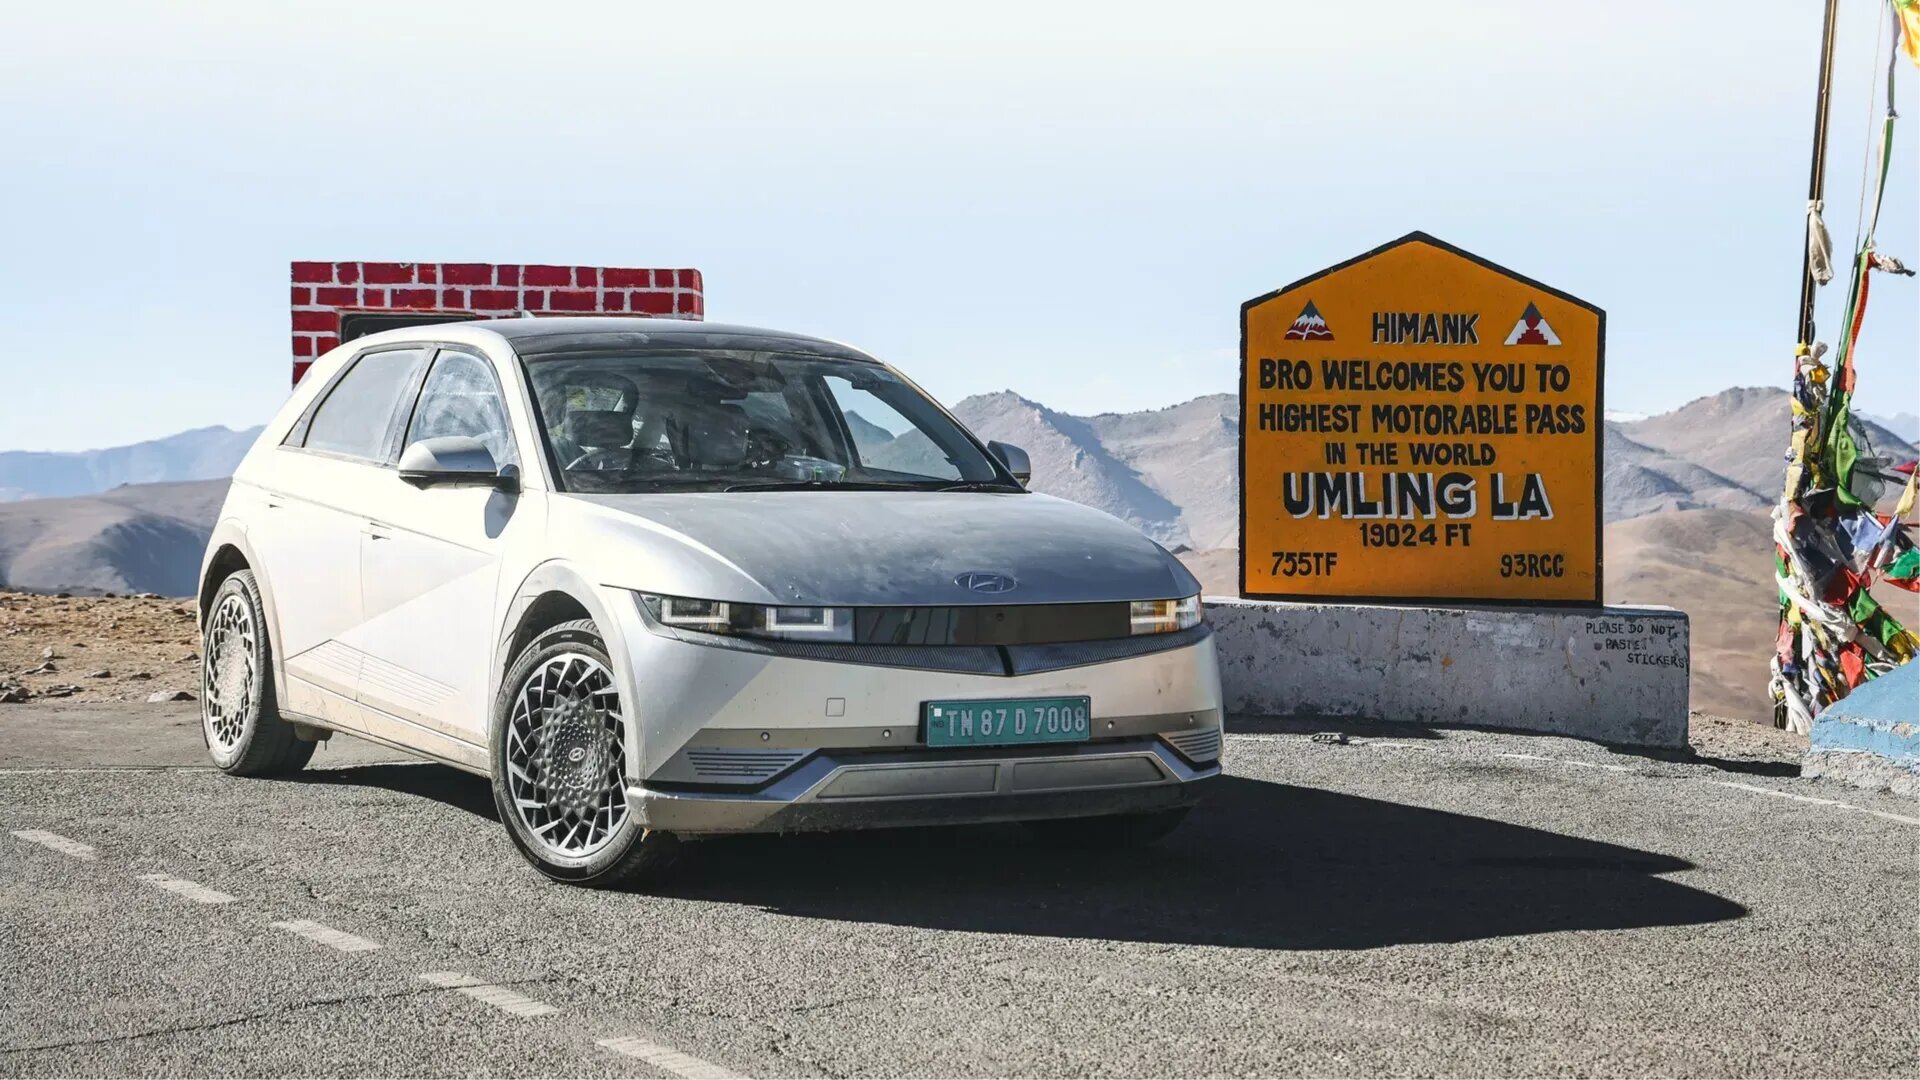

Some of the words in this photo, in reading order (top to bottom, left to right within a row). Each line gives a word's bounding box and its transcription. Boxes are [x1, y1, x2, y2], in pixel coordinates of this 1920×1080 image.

[1372, 312, 1480, 345] HIMANK
[1259, 358, 1312, 390] BRO
[1322, 360, 1464, 392] WELCOMES
[1472, 363, 1525, 393] YOU
[1536, 364, 1570, 393] TO
[1259, 403, 1361, 433] HIGHEST
[1372, 404, 1517, 435] MOTORABLE
[1526, 404, 1585, 434] PASS
[1325, 442, 1346, 465] IN
[1356, 443, 1398, 465] THE
[1409, 443, 1496, 466] WORLD
[1283, 472, 1477, 520] UMLING
[1490, 472, 1554, 520] LA
[1360, 523, 1437, 547] 19024
[1445, 524, 1472, 546] FT
[1271, 552, 1338, 577] 755TF
[1500, 553, 1564, 578] 93RCC
[1586, 622, 1624, 635] PLEASE
[1628, 624, 1644, 634] DO
[1651, 625, 1675, 636] NOT
[1605, 638, 1640, 650] PASTE
[1626, 653, 1684, 668] STICKERS
[946, 709, 973, 737] TN
[980, 708, 1008, 736] 87
[1015, 708, 1027, 735] D
[1033, 706, 1085, 734] 7008
